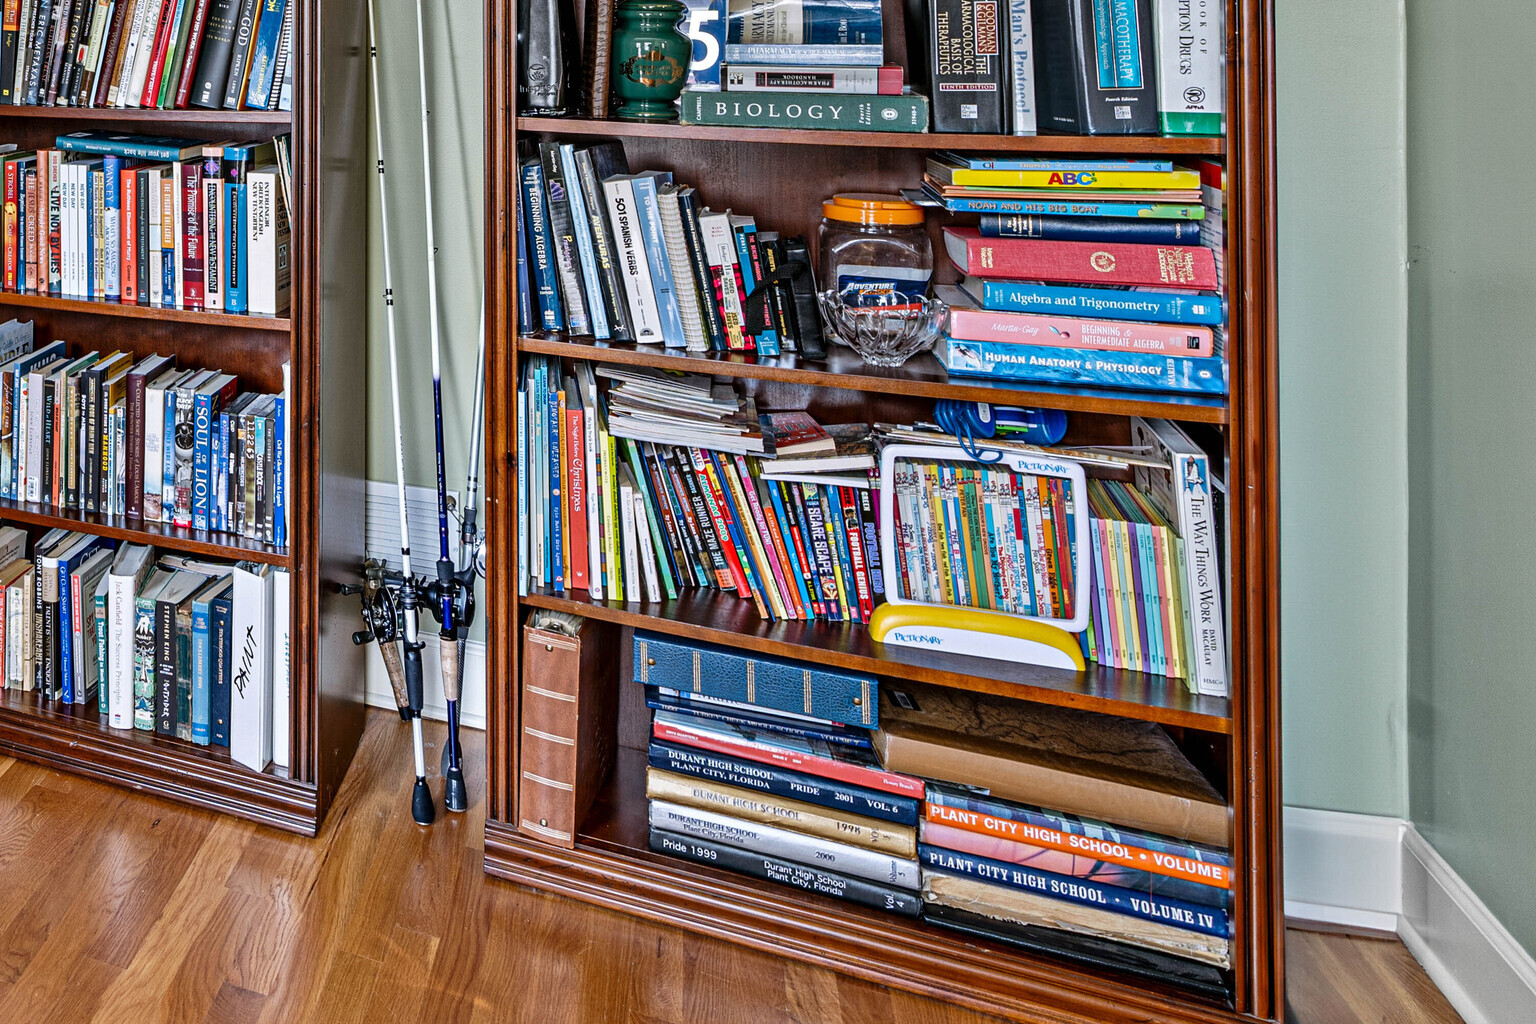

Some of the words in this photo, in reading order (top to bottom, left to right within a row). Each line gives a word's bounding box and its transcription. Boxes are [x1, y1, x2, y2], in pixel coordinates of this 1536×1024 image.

[986, 3, 996, 53] GOODMAN
[1010, 0, 1026, 48] Man's
[938, 11, 950, 75] THERAPEUTICS
[1179, 36, 1195, 75] DRUGS
[1014, 50, 1030, 114] Protocol
[715, 102, 844, 120] BIOLOGY
[105, 164, 114, 202] YANCEY
[1048, 172, 1098, 185] ABC's
[50, 190, 60, 212] LIVE
[968, 202, 997, 210] NOAH
[1001, 202, 1022, 211] AND
[1048, 204, 1067, 212] BIG
[1071, 205, 1099, 214] BOAT
[51, 215, 59, 233] NOT
[51, 237, 59, 249] BY
[591, 214, 611, 270] AVENTURAS
[51, 253, 60, 273] LIES
[1008, 292, 1052, 306] Algebra
[1054, 297, 1076, 306] and
[1078, 297, 1161, 314] Trigonometry
[991, 322, 1040, 336] Martin-Gay
[1081, 336, 1130, 347] INTERMEDIATE
[1133, 340, 1165, 350] ALGEBRA
[985, 352, 1026, 365] HUMAN
[1028, 354, 1082, 368] ANATOMY
[1084, 361, 1092, 370] &
[1096, 361, 1162, 375] PHYSIOLOGY
[196, 407, 208, 448] SOUL
[202, 455, 207, 464] OF
[1018, 461, 1068, 474] PICTIONARY
[195, 467, 208, 510] LION
[692, 496, 711, 528] RUNNER
[1190, 497, 1205, 518] THE
[706, 529, 720, 549] MAZE
[1192, 520, 1207, 546] WAY
[712, 549, 724, 567] THE
[1194, 547, 1210, 587] THINGS
[1199, 589, 1212, 624] WORK
[894, 632, 942, 645] PICTIONARY
[234, 625, 258, 700] PAINT
[668, 751, 706, 765] DURANT
[708, 758, 733, 772] HIGH
[734, 764, 774, 781] SCHOOL
[671, 761, 701, 773] PLANT
[703, 767, 727, 780] CITY,
[729, 773, 770, 789] FLORIDA
[693, 789, 730, 804] DURANT
[733, 797, 758, 810] HIGH
[761, 804, 802, 821] SCHOOL
[836, 821, 861, 835] 1998
[791, 783, 820, 796] PRIDE
[835, 792, 854, 804] 2001
[867, 800, 891, 812] VOL.
[892, 805, 899, 814] 6
[668, 812, 702, 825] DURANT
[703, 819, 725, 830] HIGH
[726, 825, 760, 840] SCHOOL
[663, 839, 687, 853] Pride
[691, 845, 717, 860] 1999
[815, 851, 835, 862] 2000
[931, 806, 979, 826] PLANT
[983, 818, 1018, 835] CITY
[1023, 826, 1062, 845] HIGH
[1069, 835, 1134, 860] SCHOOL
[1152, 853, 1223, 880] VOLUME
[764, 861, 793, 876] Durant
[795, 869, 815, 881] High
[817, 874, 847, 889] School
[767, 870, 790, 883] Plant
[791, 875, 812, 888] City,
[814, 882, 843, 896] Florida
[928, 852, 973, 873] PLANT
[977, 861, 1009, 881] CITY
[1012, 871, 1047, 891] HIGH
[1050, 879, 1108, 904] SCHOOL
[1130, 897, 1194, 925] VOLUME
[1197, 912, 1214, 929] IV
